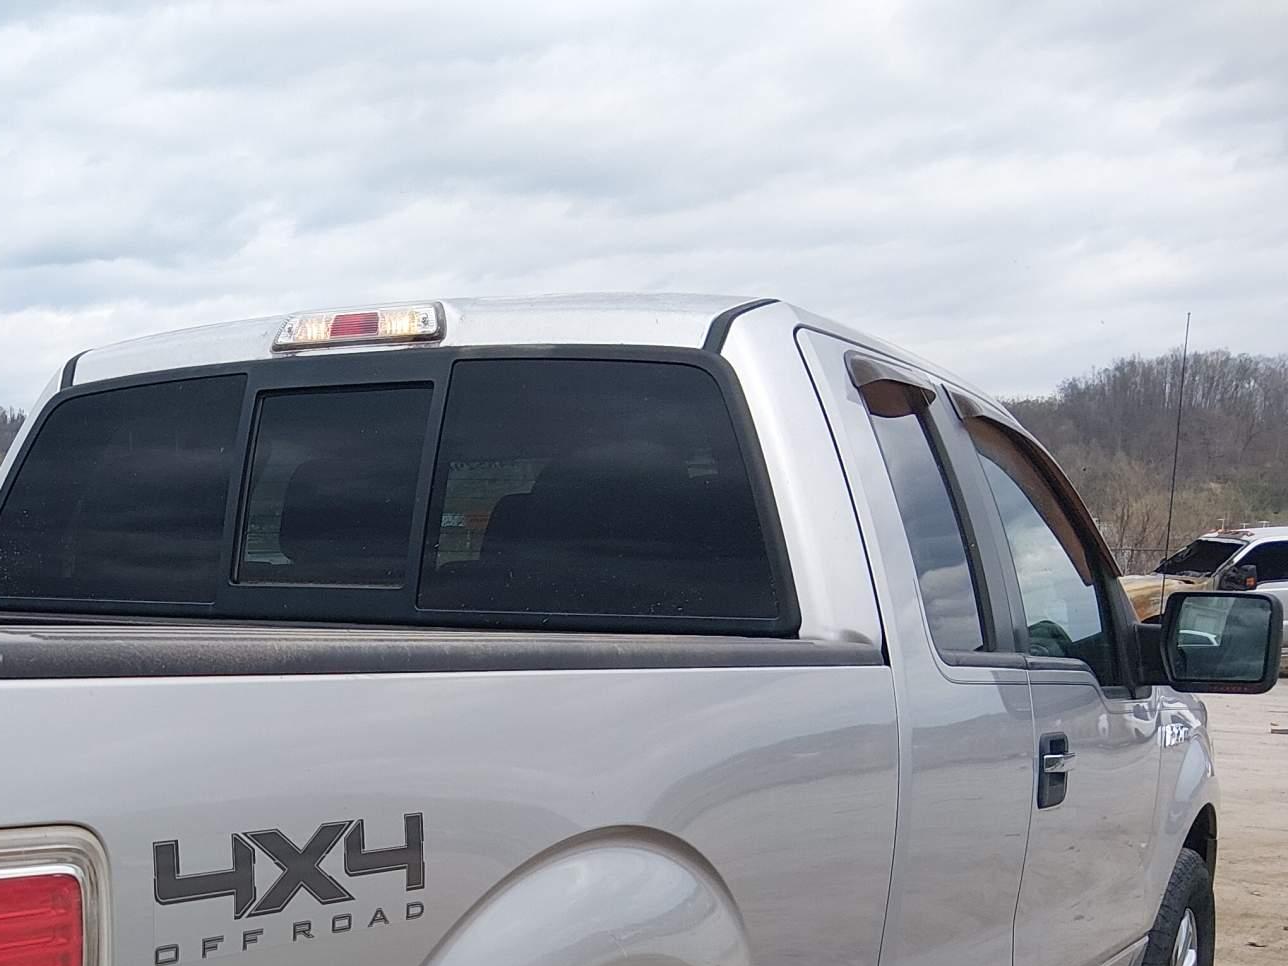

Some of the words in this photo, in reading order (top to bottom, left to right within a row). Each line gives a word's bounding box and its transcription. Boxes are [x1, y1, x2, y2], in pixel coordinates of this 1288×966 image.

[153, 813, 424, 919] 4X4
[155, 935, 263, 966] OFF
[292, 902, 425, 941] ROAD
